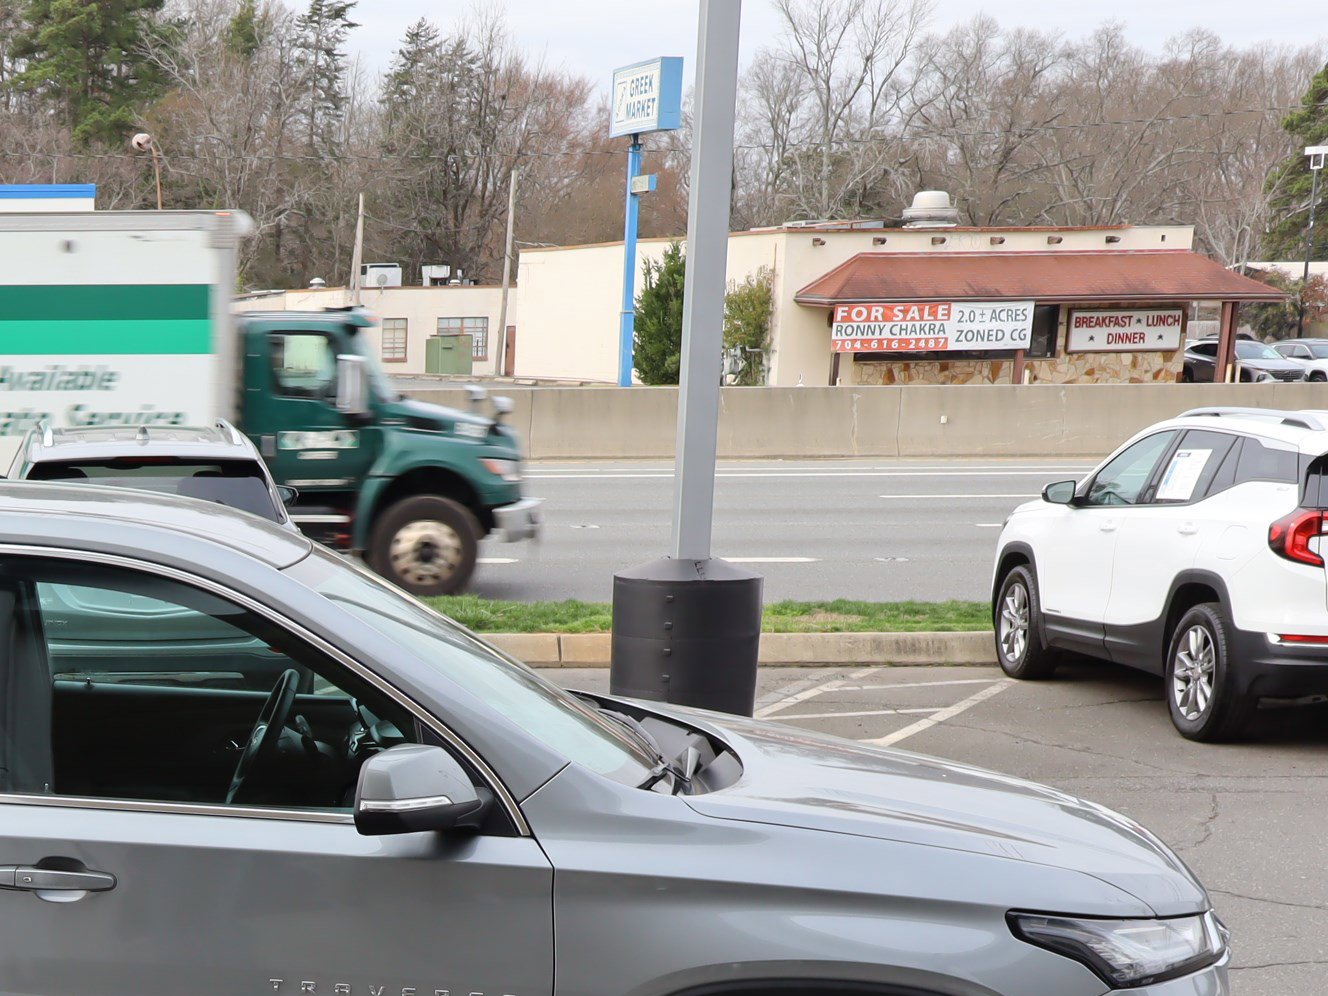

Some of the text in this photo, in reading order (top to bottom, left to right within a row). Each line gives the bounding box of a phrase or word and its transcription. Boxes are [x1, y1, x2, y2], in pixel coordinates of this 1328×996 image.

[629, 74, 654, 98] GREEK
[626, 97, 656, 119] MARKET
[836, 305, 949, 321] FOR SALE
[957, 309, 975, 323] 2.0
[989, 308, 1028, 323] ACRES
[1074, 314, 1181, 328] BREAKFAST LUNCH
[835, 323, 947, 337] RONNY CHAKRA
[955, 328, 1027, 343] ZONED CG
[835, 338, 945, 349] 704-616-2487
[1106, 332, 1146, 345] DINNER
